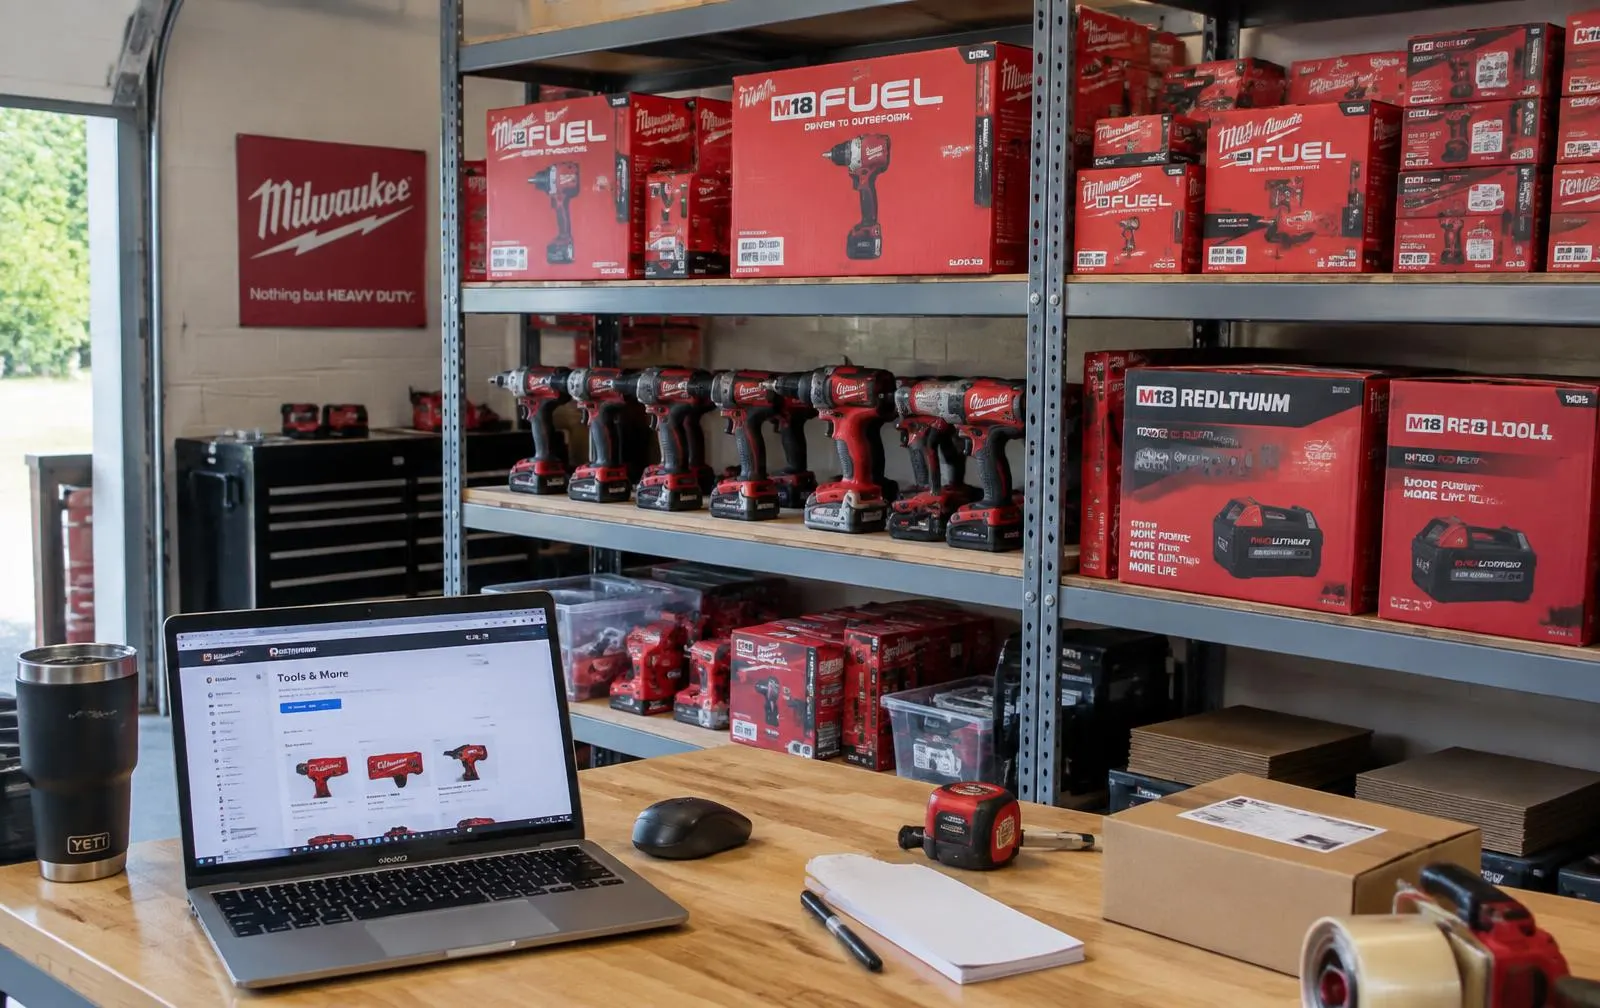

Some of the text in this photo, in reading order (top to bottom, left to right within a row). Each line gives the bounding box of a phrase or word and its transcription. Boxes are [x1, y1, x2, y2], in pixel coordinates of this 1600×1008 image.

[772, 93, 815, 120] M18
[820, 78, 943, 117] FUEL
[528, 120, 607, 147] FUEL
[840, 119, 849, 128] TO
[1257, 142, 1346, 163] FUEL
[249, 172, 411, 240] Milwaukee
[250, 288, 300, 303] Nothing
[304, 289, 323, 301] but
[327, 289, 373, 302] HEAVY
[1137, 386, 1177, 407] M18
[1407, 414, 1443, 433] M18
[277, 673, 306, 683] Tools
[309, 671, 317, 681] &
[72, 836, 107, 851] YETI
